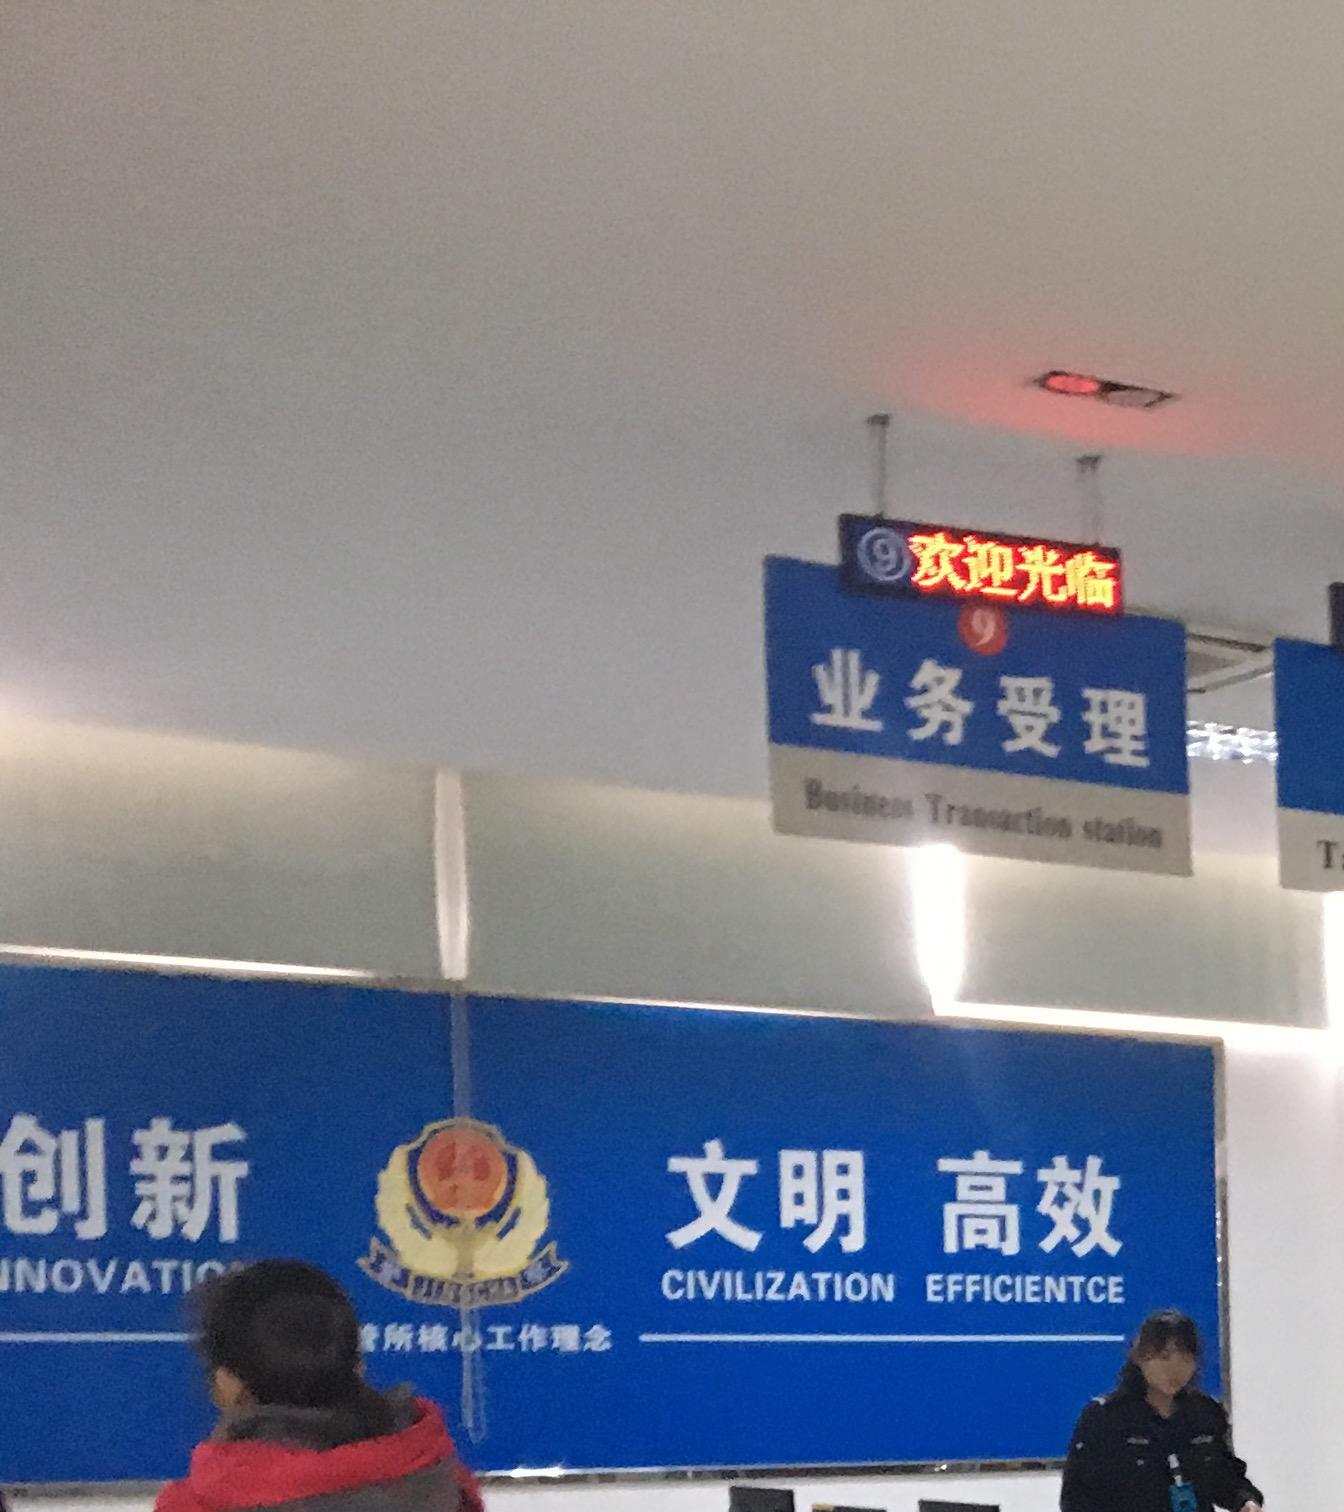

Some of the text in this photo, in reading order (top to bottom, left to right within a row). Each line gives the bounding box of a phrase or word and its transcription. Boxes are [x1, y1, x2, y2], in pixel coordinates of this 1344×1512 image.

[908, 531, 1117, 608] 欢迎光临
[968, 606, 999, 648] 9
[811, 648, 1150, 768] 业务受理
[804, 777, 912, 820] Business
[924, 793, 1074, 840] Transaction
[0, 1112, 1124, 1259] 创新 文明 高效
[660, 1268, 896, 1303] CIVILIZATION
[925, 1273, 1126, 1304] EFFICIENTCE
